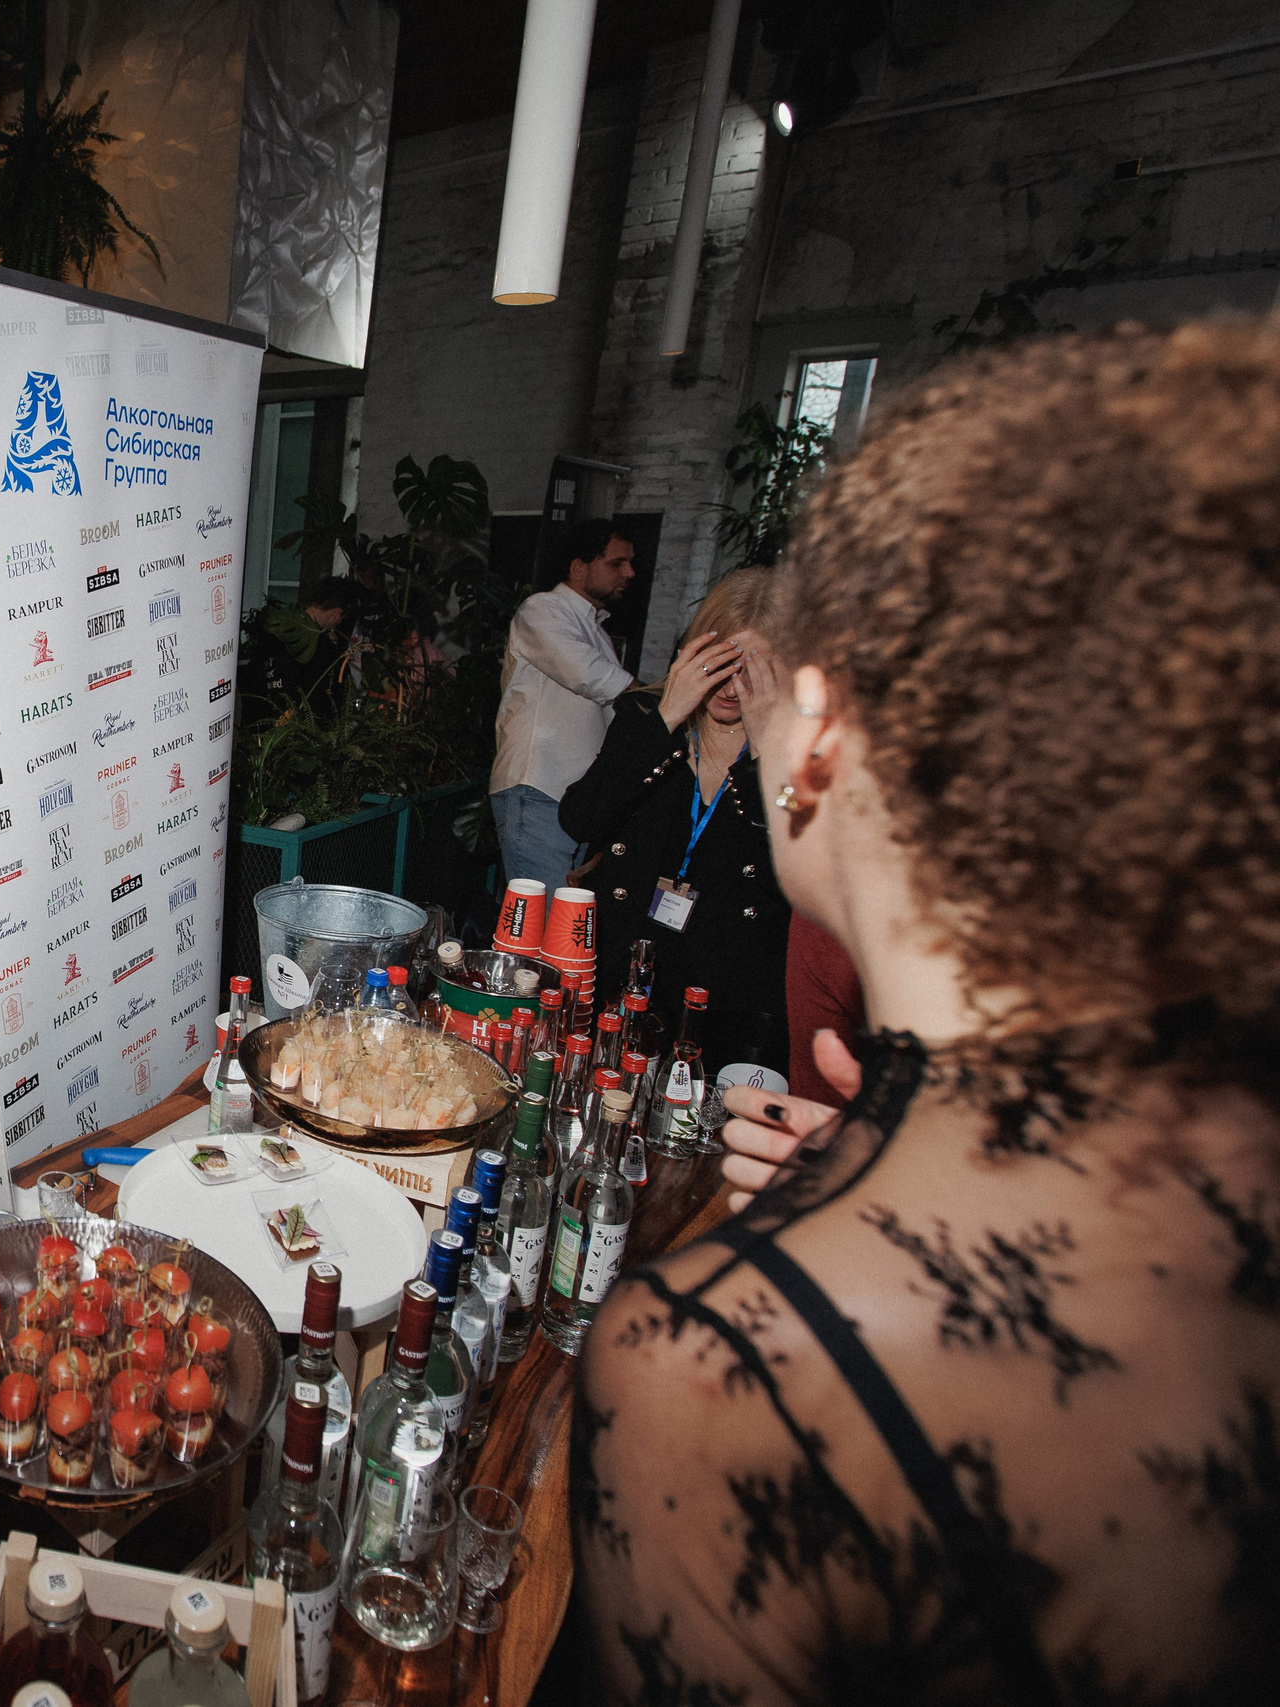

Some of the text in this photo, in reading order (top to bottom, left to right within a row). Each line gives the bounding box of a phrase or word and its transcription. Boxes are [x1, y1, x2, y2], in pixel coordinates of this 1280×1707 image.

[106, 397, 214, 435] Алкогольная
[105, 427, 201, 461] Сибирская
[105, 457, 168, 489] Группа
[79, 519, 121, 546] BROOM
[138, 553, 186, 579] GASTRONOM
[200, 553, 233, 573] PRUNIER
[88, 572, 119, 590] SIBSA
[8, 596, 64, 621] RAMPUR
[86, 608, 125, 639] SIBBITTER
[26, 741, 78, 774] GASTRONOM
[152, 732, 194, 758] RAMPUR
[97, 756, 138, 783] PRUNIER
[104, 832, 144, 865] BROOM
[160, 844, 201, 876] GASTRONOM
[112, 877, 142, 899] SIBSA
[111, 906, 148, 941] SIBBITTER
[512, 899, 525, 936] SIBSA
[46, 920, 90, 954] RAMPUR
[171, 994, 208, 1026] RAMPUR
[56, 1031, 104, 1071] GASTRONOM
[121, 1028, 158, 1060] PRUNIER
[5, 1077, 38, 1105] SIBSA
[4, 1105, 46, 1148] SIBBITTER
